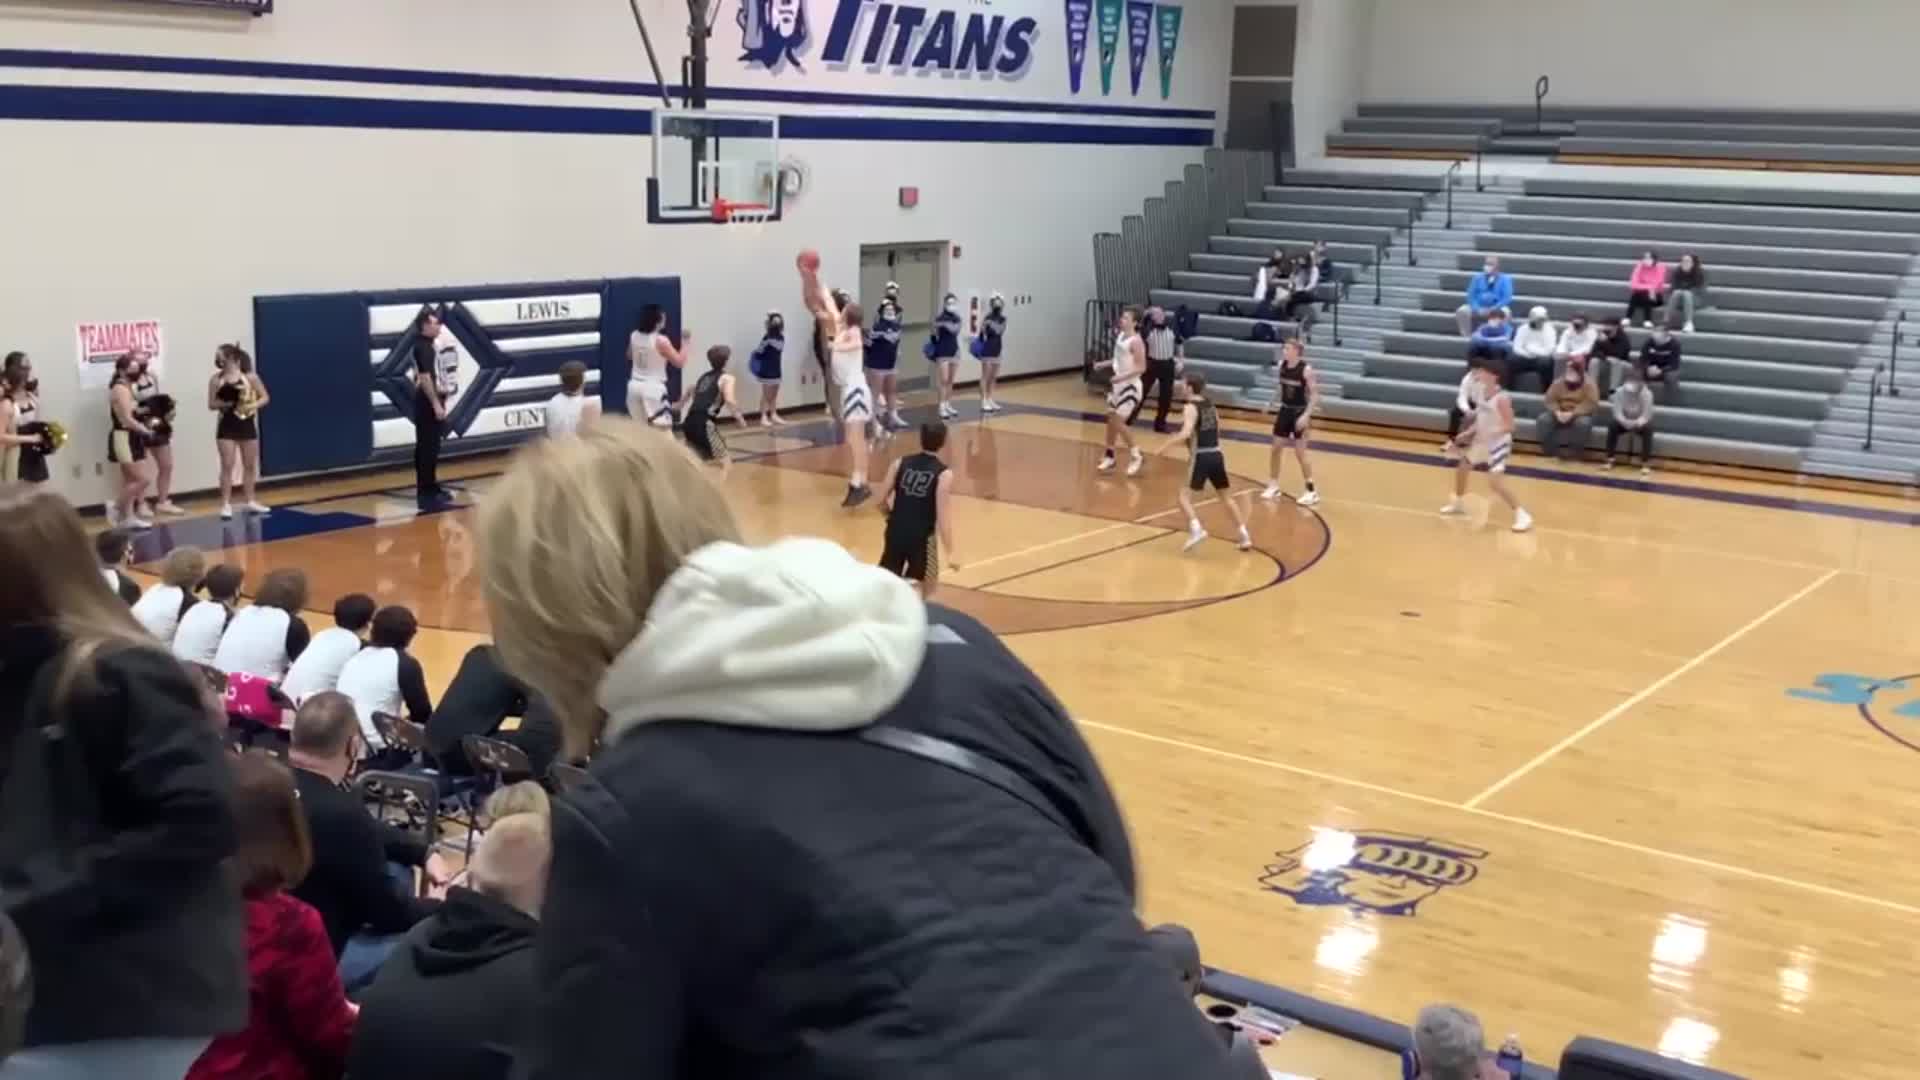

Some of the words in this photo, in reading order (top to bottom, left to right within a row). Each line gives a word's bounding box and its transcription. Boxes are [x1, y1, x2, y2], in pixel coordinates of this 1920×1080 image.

[821, 0, 1037, 74] TITANS
[516, 301, 570, 320] LEWIS
[80, 321, 159, 362] TEAMMATES
[901, 468, 935, 497] 42
